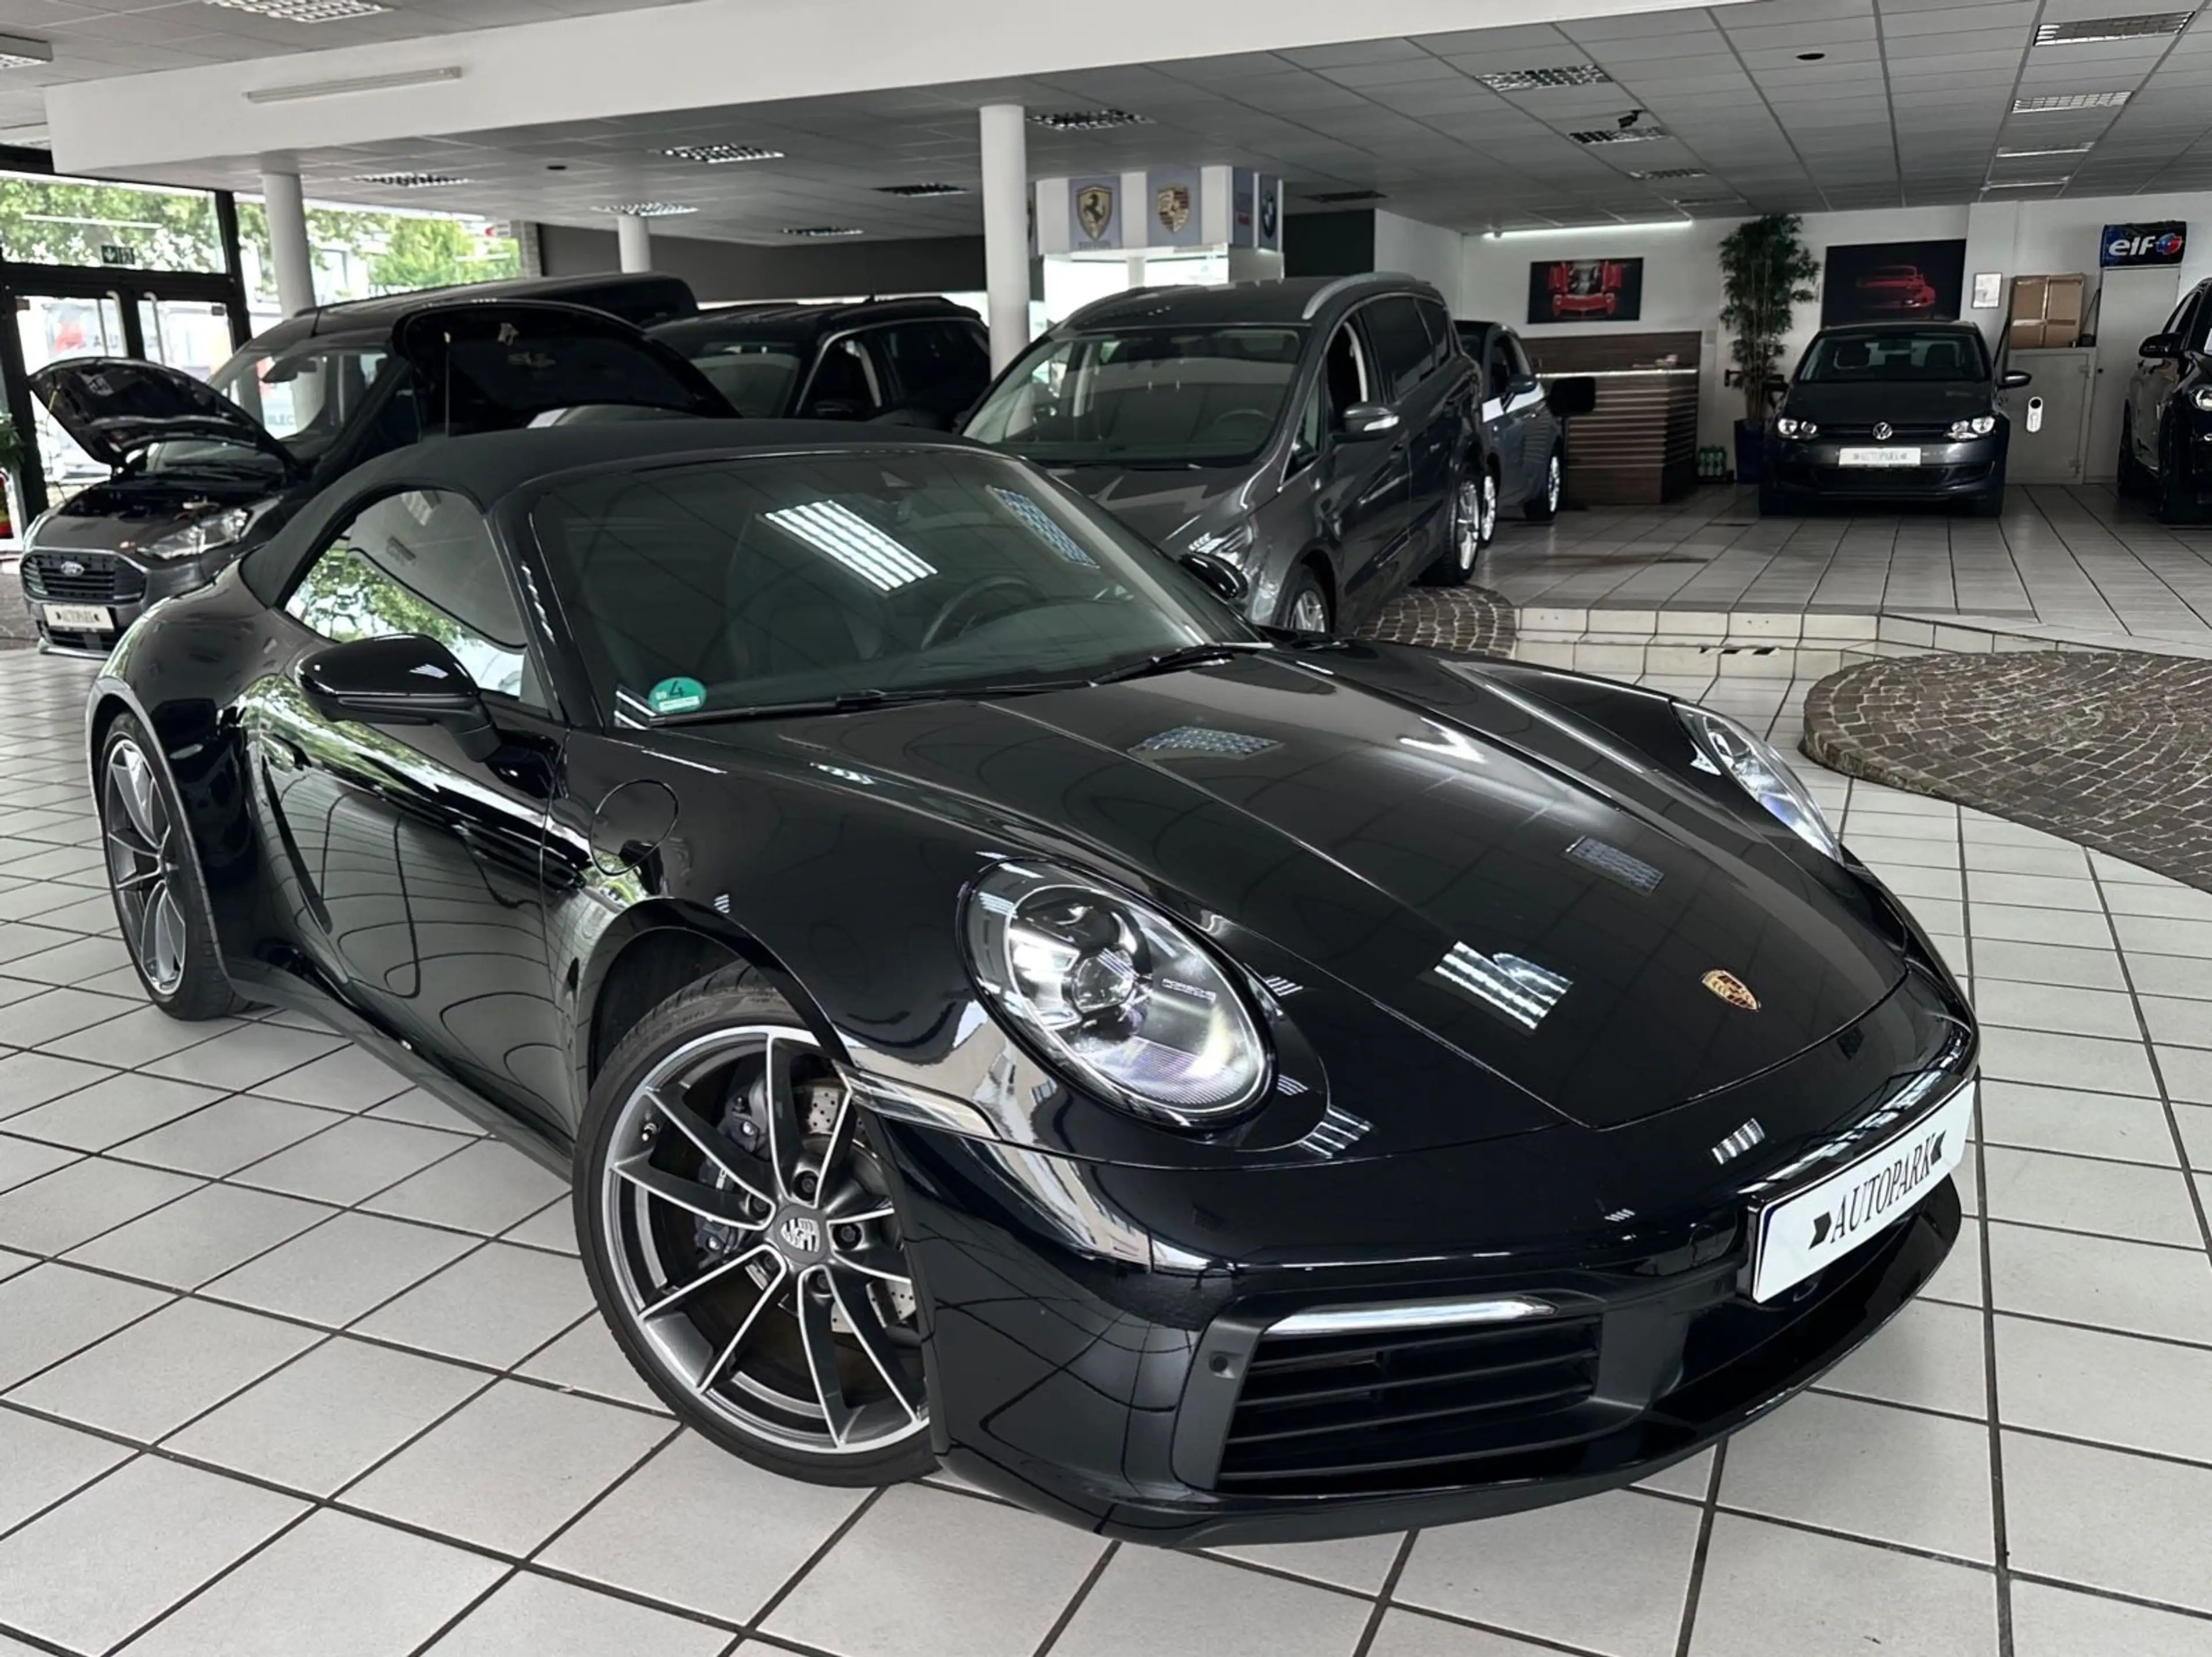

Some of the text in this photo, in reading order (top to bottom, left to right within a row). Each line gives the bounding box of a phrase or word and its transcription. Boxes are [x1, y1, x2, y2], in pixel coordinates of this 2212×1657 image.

[2109, 235, 2156, 256] elf
[669, 680, 684, 697] 4
[1830, 1132, 1936, 1243] AUTOPARK
